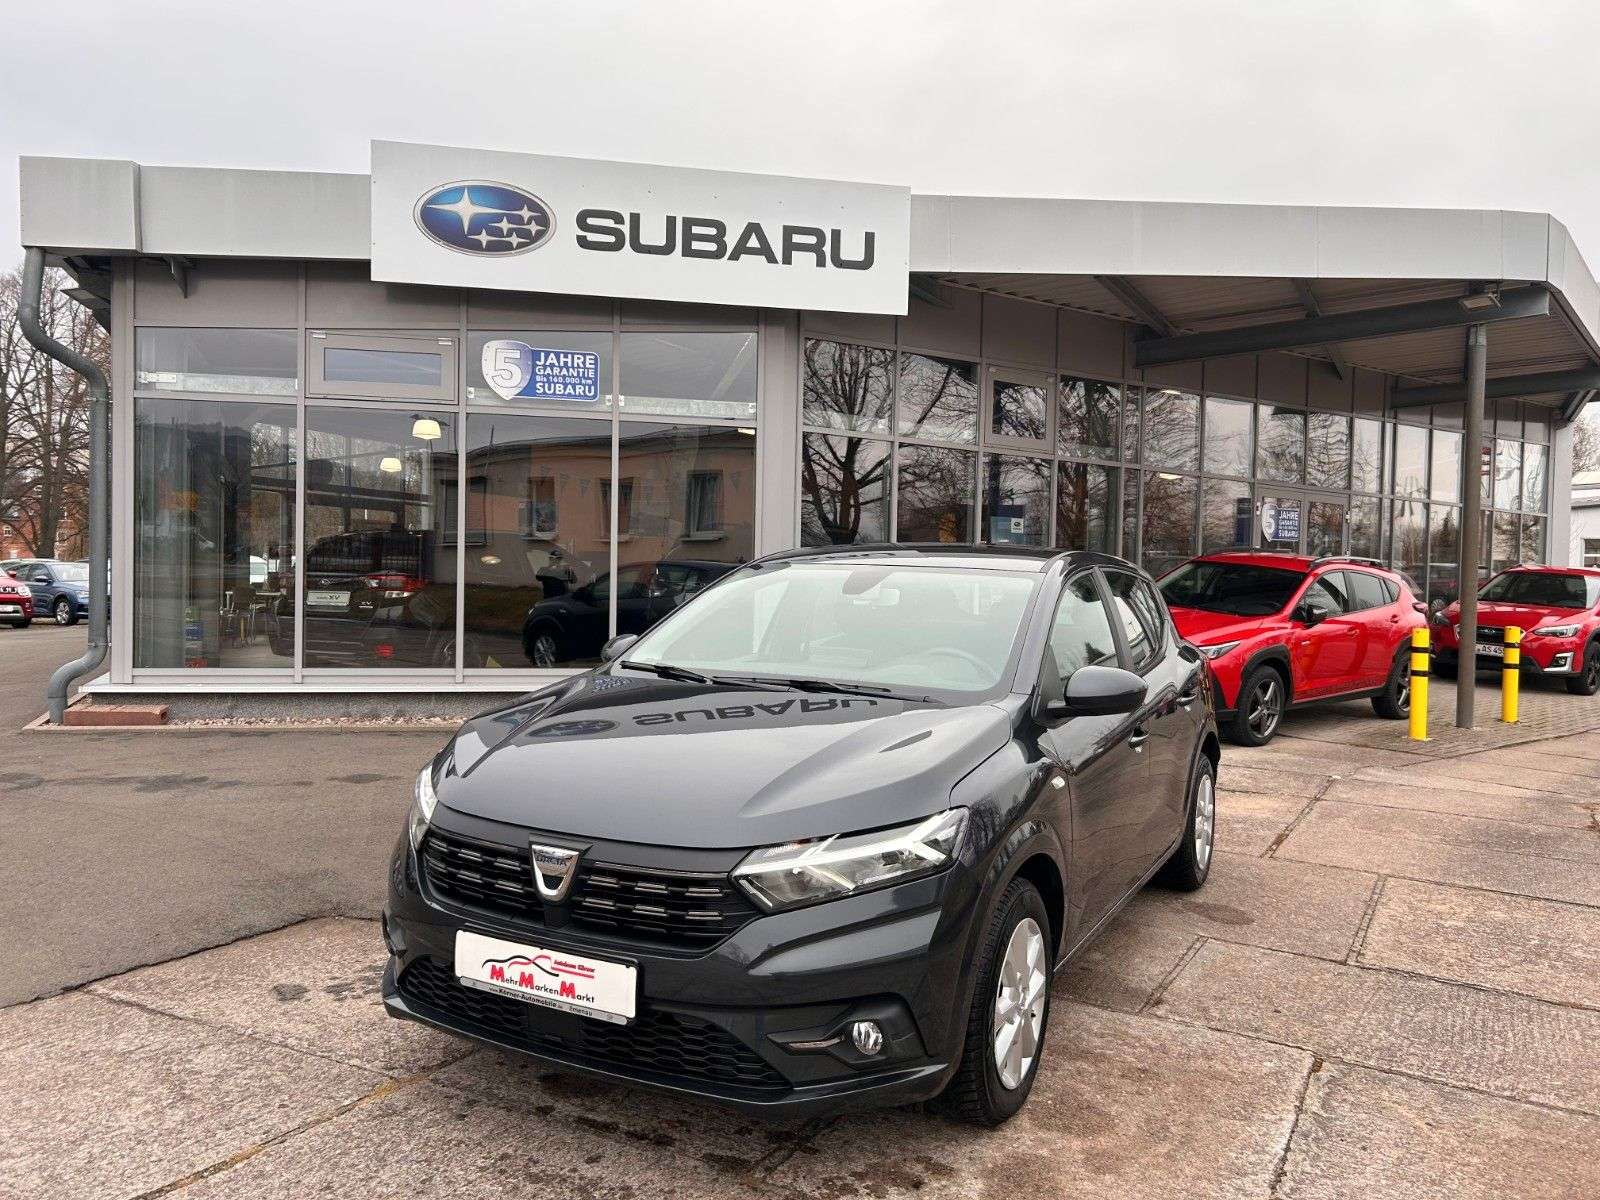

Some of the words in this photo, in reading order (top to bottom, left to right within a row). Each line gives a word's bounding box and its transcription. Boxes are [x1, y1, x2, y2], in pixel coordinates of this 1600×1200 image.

[575, 208, 876, 271] SUBARU
[535, 352, 595, 368] JAHRE
[492, 348, 522, 388] 5
[535, 366, 595, 377] GARANTIE
[535, 383, 595, 396] SUBARU
[1278, 511, 1299, 520] JAHRE
